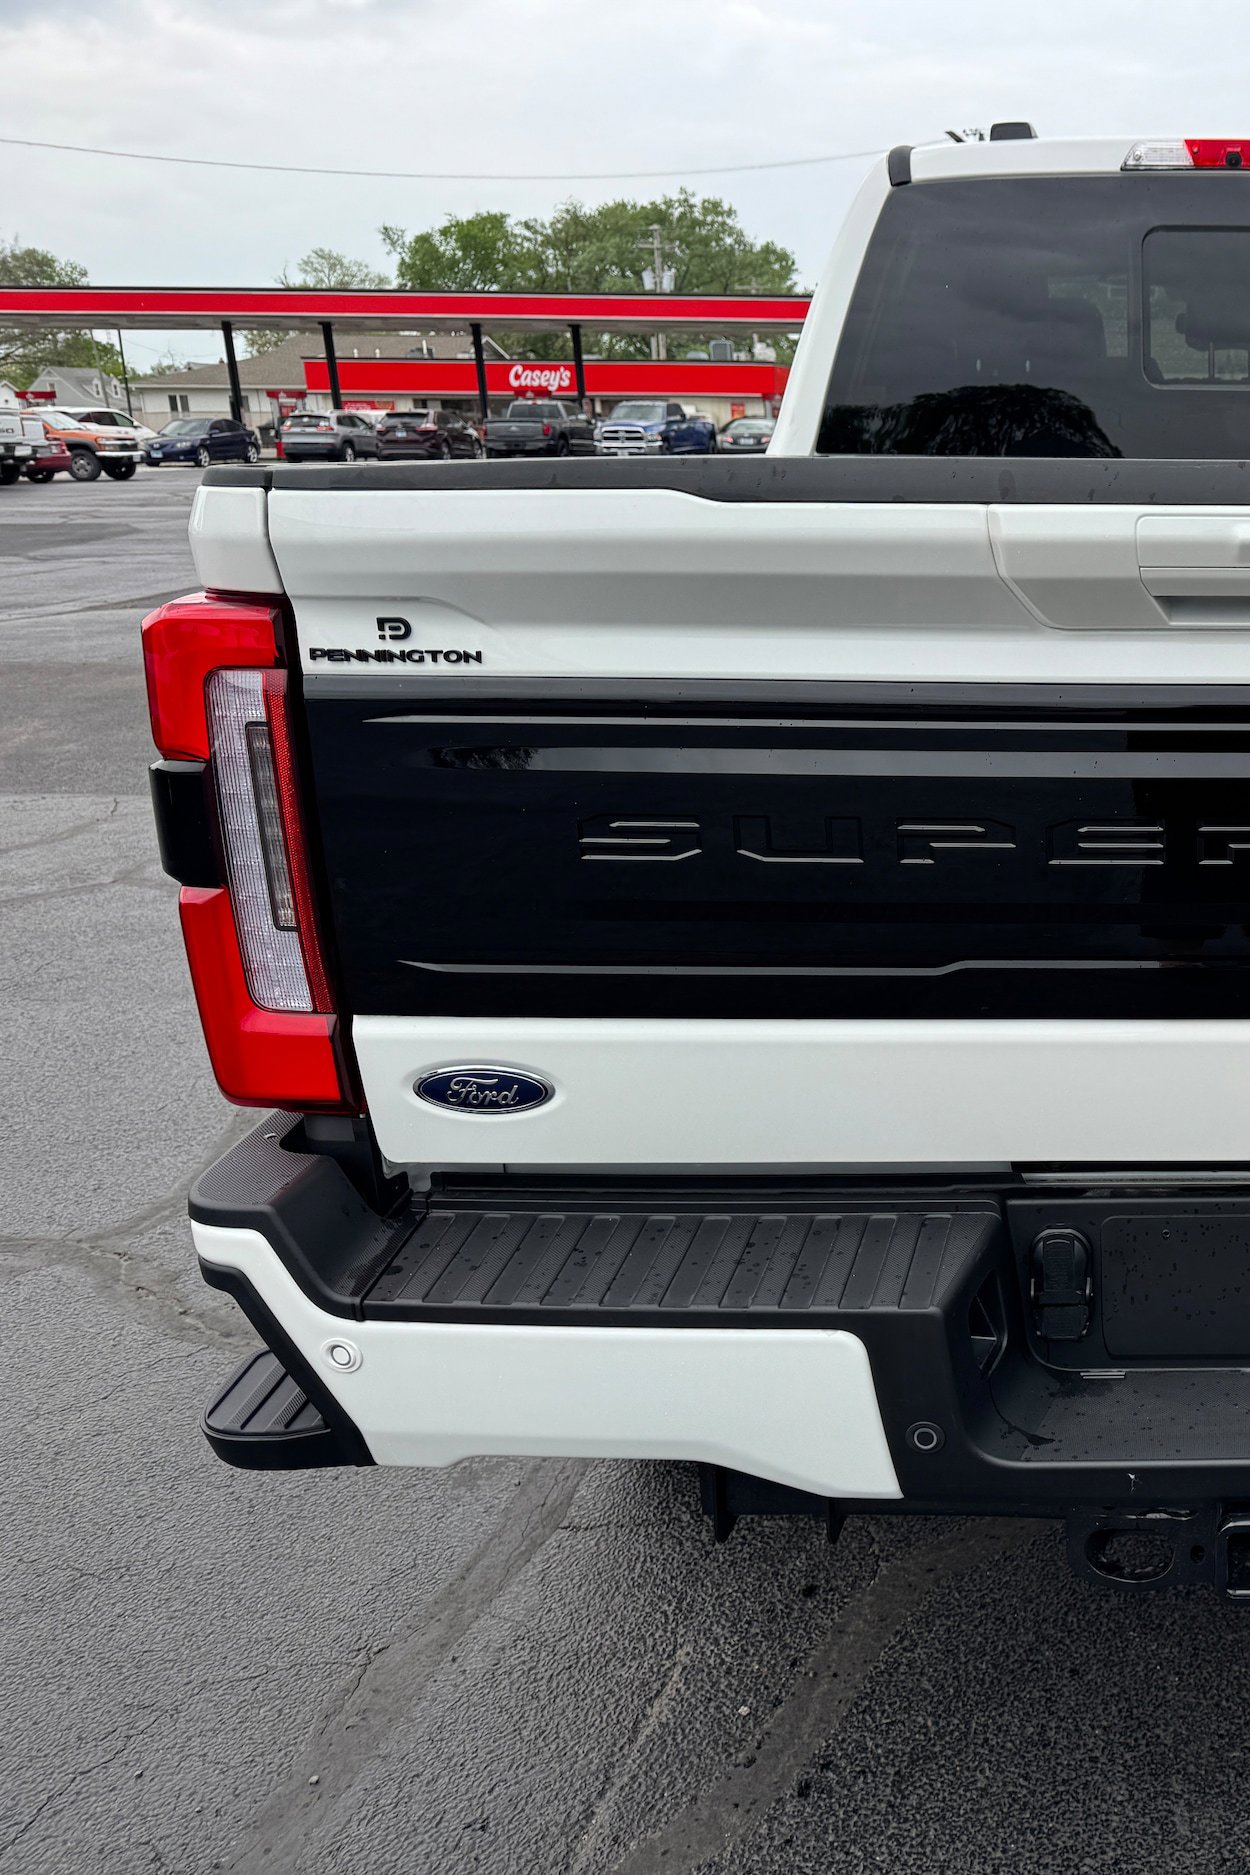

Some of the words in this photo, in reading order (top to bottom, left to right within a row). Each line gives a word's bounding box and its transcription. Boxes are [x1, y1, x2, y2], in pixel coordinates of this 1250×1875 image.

[509, 365, 571, 391] Casey's
[309, 648, 482, 664] PENNINGTON
[447, 1076, 519, 1106] Ford
